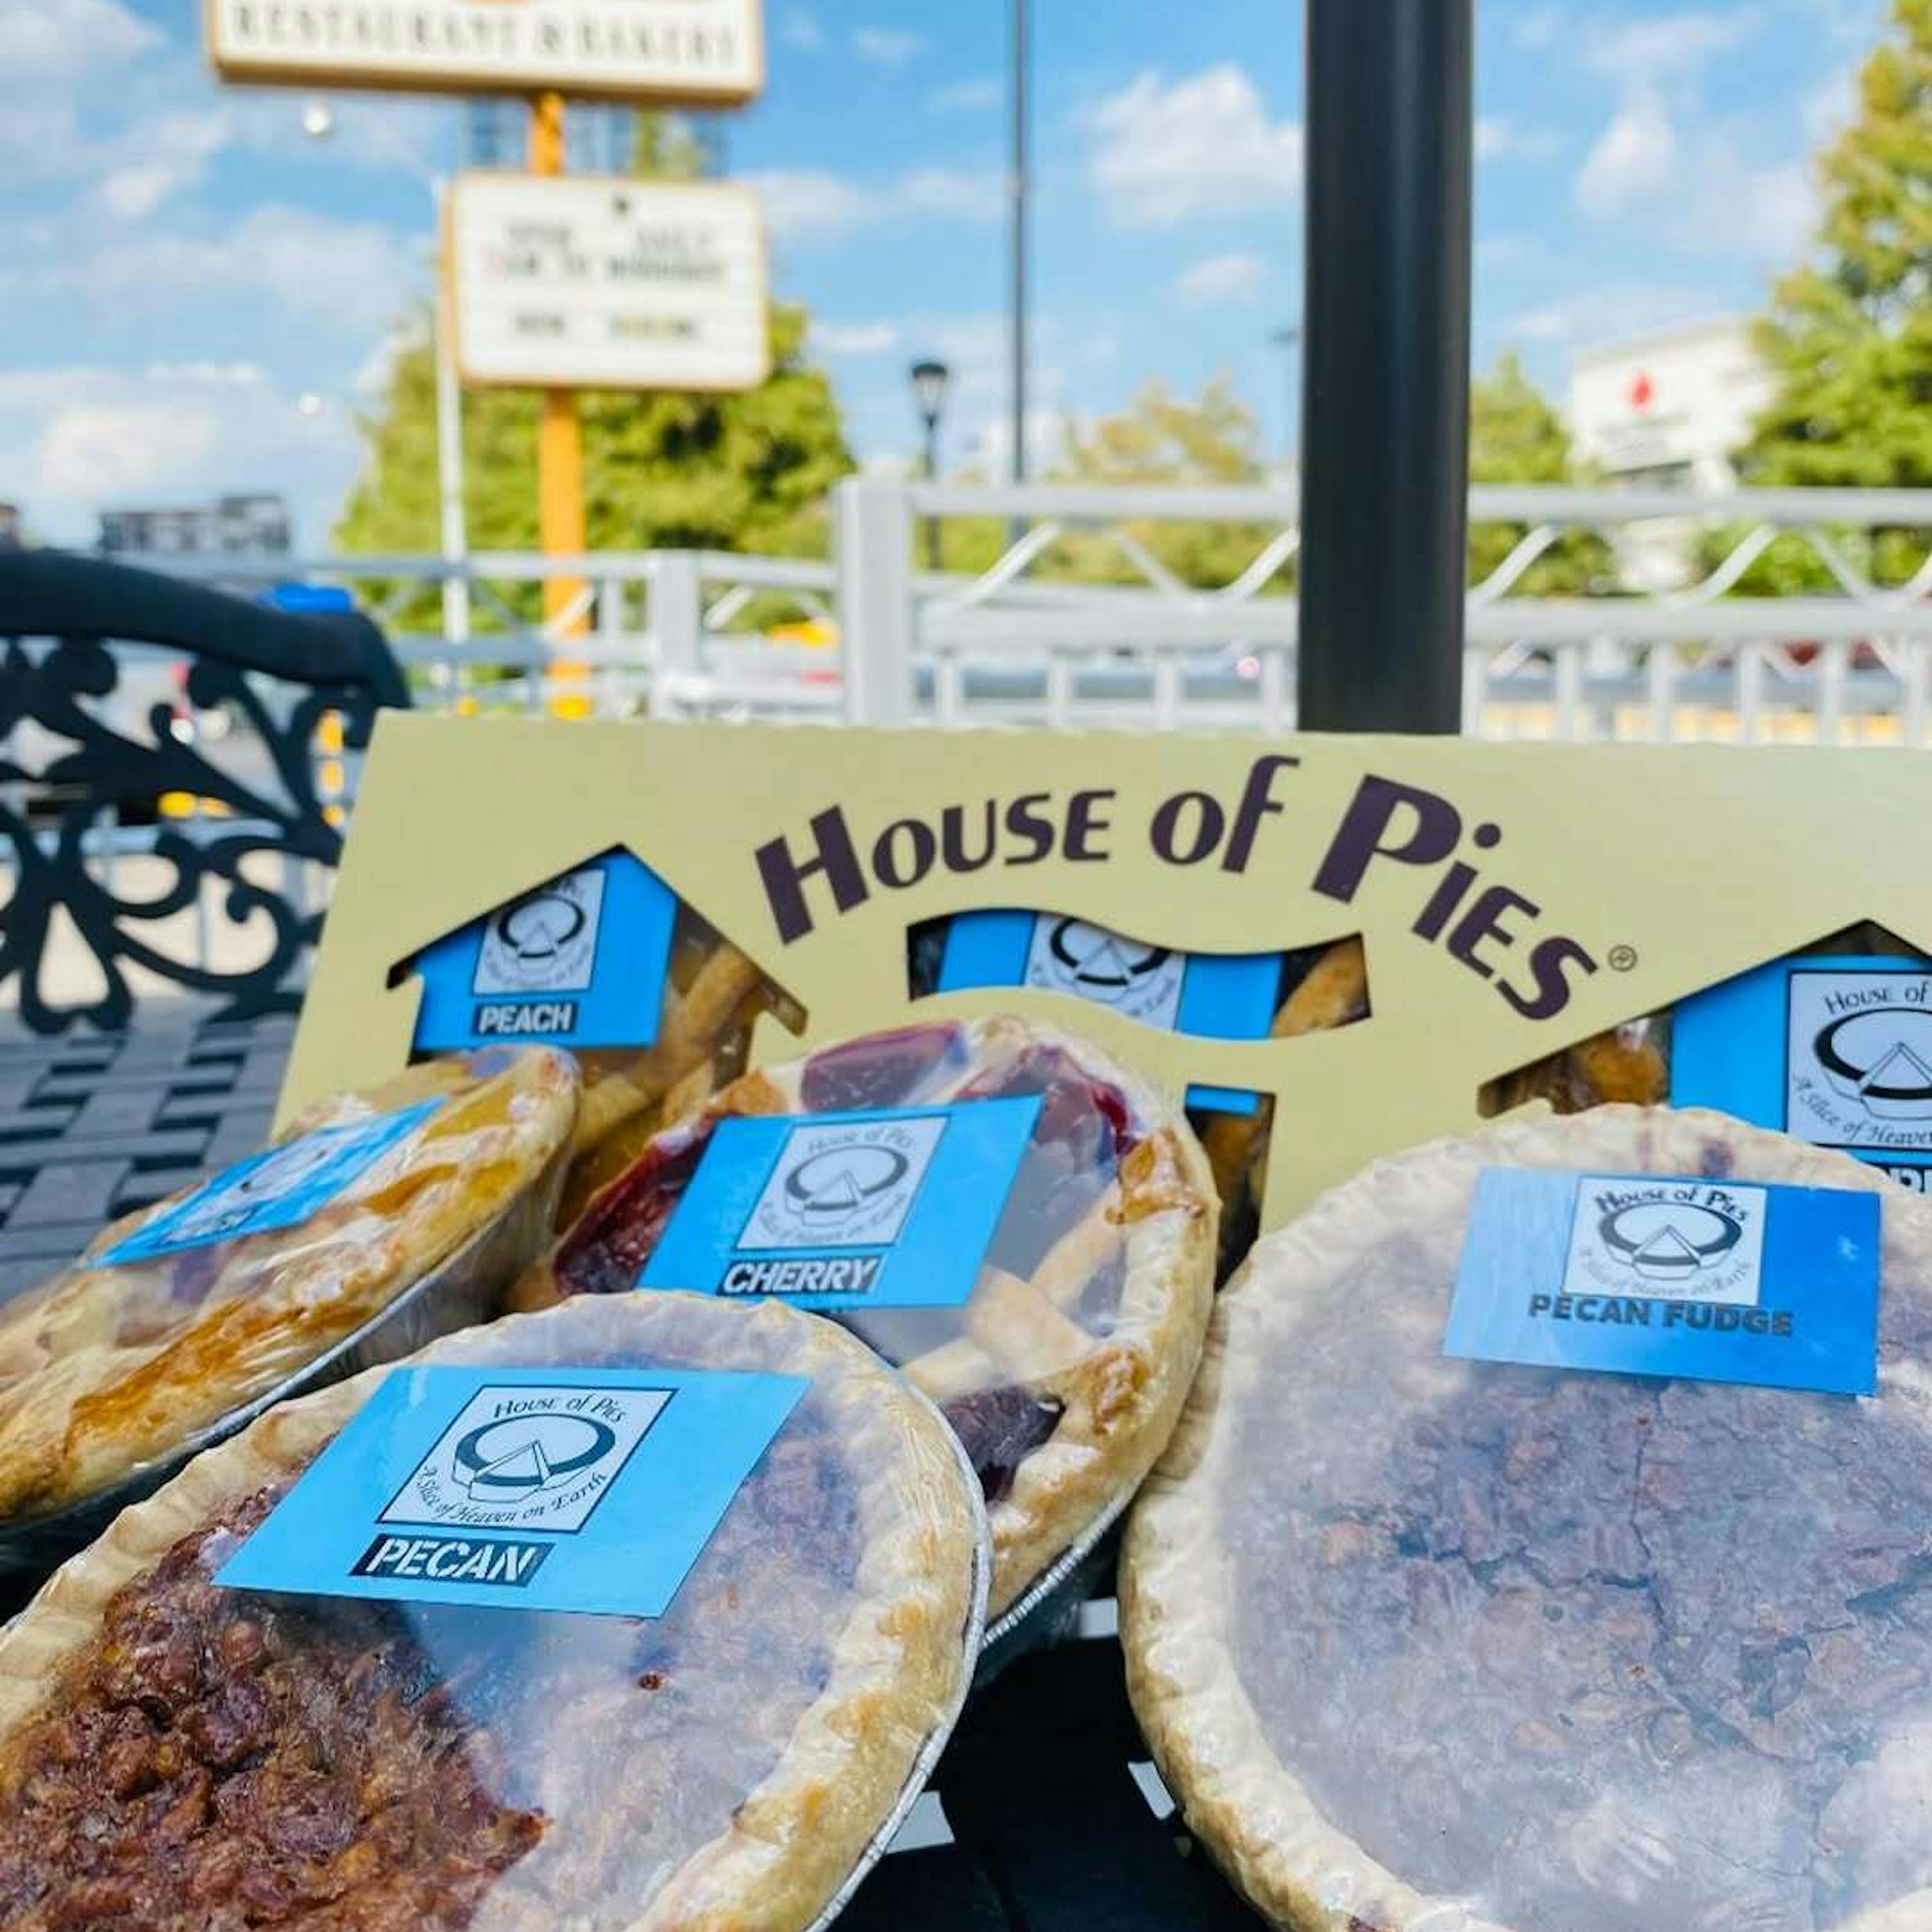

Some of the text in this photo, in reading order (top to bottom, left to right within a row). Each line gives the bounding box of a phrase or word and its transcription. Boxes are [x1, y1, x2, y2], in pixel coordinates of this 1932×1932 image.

[1150, 754, 1300, 874] of
[1905, 980, 1930, 1003] of
[478, 1003, 573, 1034] PEACH
[1842, 1119, 1870, 1142] of
[1673, 1185, 1698, 1201] of
[722, 1259, 878, 1294] CHERRY
[1528, 1294, 1794, 1337] PECAN FUDGE
[566, 1393, 596, 1411] of
[448, 1501, 516, 1523] Heaven
[522, 1506, 545, 1520] on
[550, 1471, 607, 1510] Earth
[366, 1539, 538, 1582] PECAN
